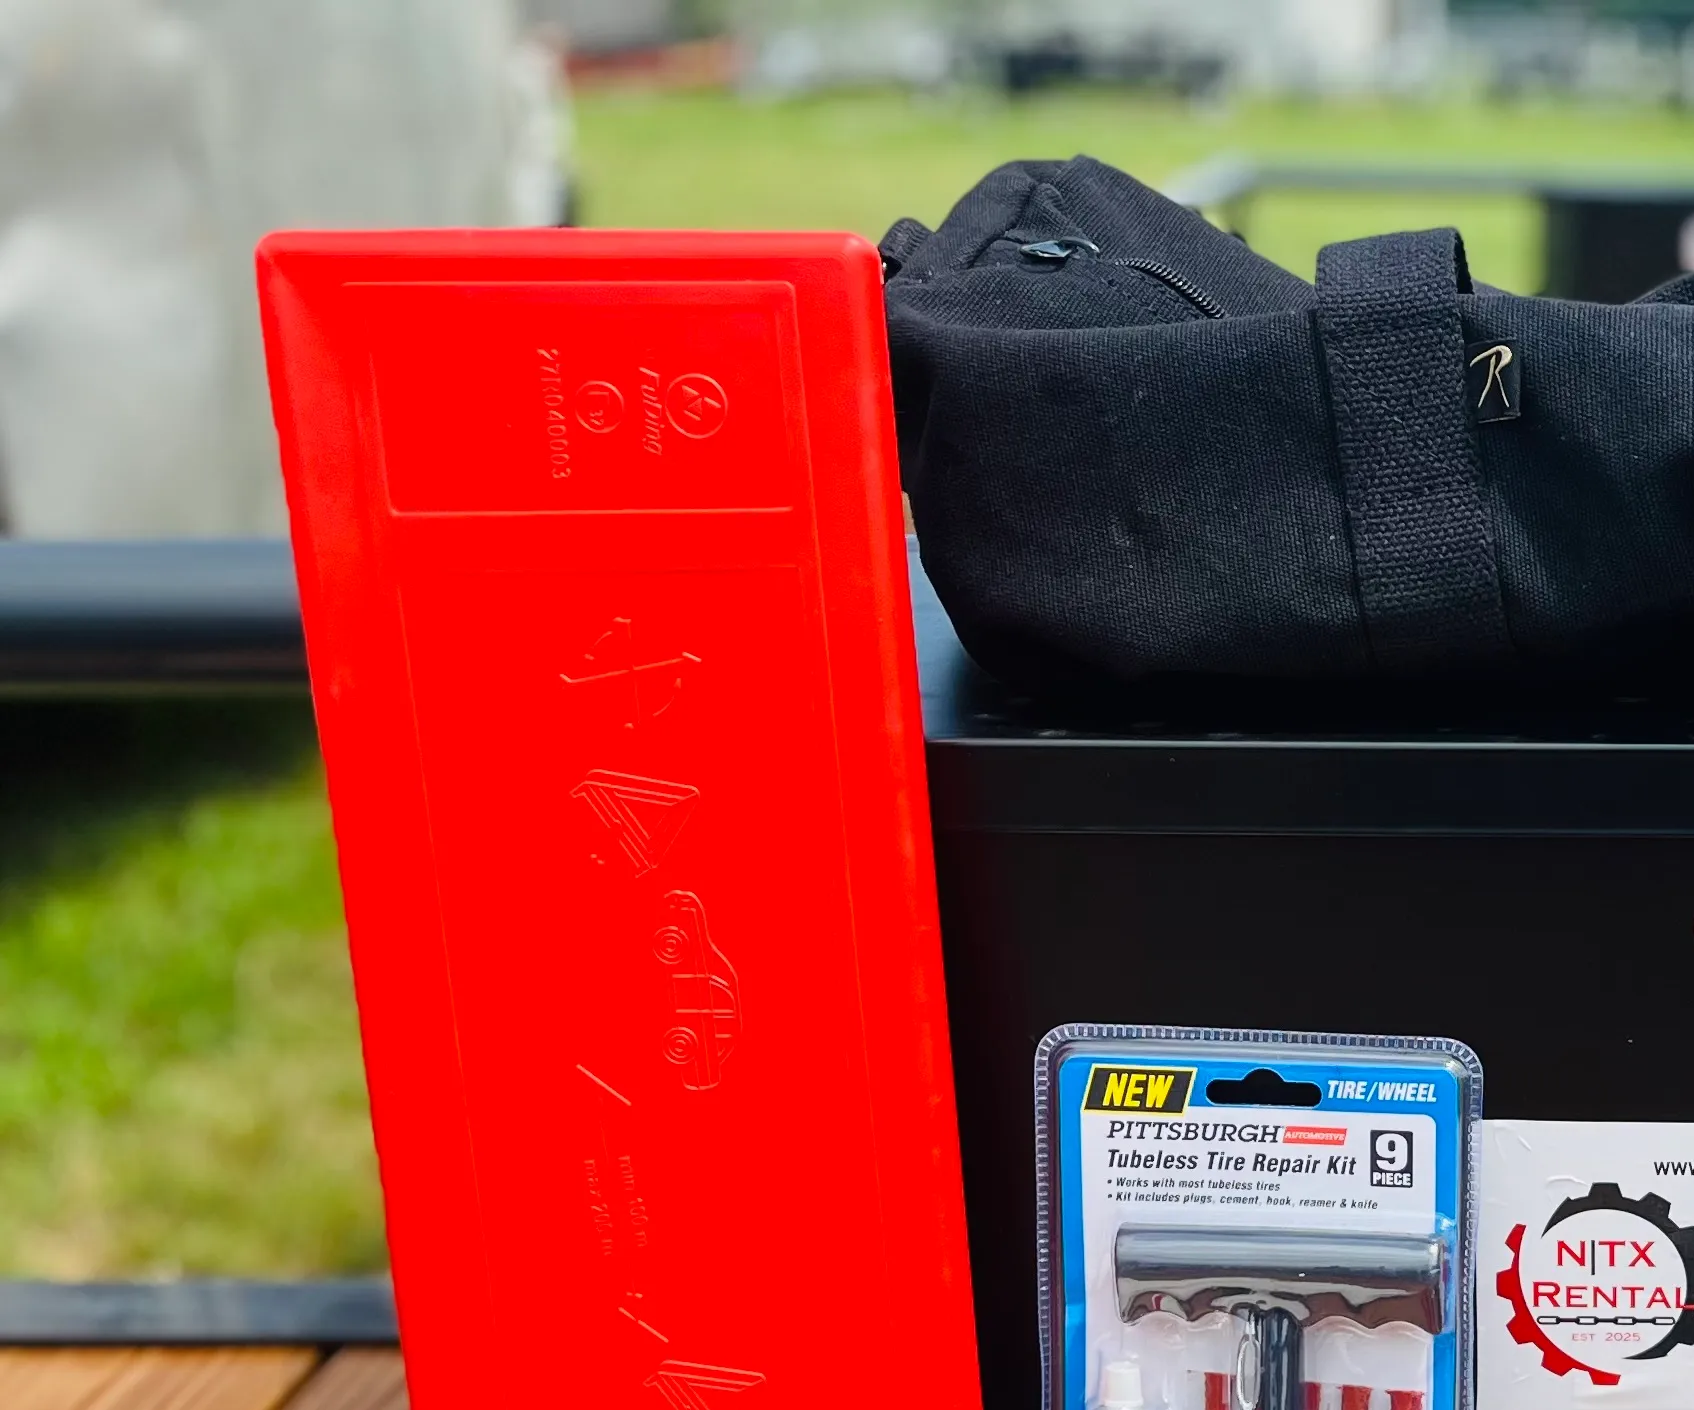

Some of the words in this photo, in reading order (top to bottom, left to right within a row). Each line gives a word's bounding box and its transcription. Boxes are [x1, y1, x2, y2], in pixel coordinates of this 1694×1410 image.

[1470, 345, 1512, 408] R
[1102, 1072, 1175, 1109] NEW
[1327, 1079, 1438, 1103] TIRE/WHEEL
[1106, 1120, 1281, 1144] PITTSBURGH
[1284, 1130, 1346, 1142] AUTOMOTIVE
[1107, 1148, 1199, 1170] Tubeless
[1207, 1151, 1245, 1171] Tire
[1252, 1153, 1321, 1177] Repair
[1326, 1155, 1357, 1176] Kit
[1375, 1132, 1409, 1172] 9
[1116, 1177, 1149, 1188] Works
[1152, 1177, 1175, 1188] with
[1178, 1179, 1204, 1189] most
[1208, 1180, 1253, 1191] tubeless
[1256, 1180, 1281, 1191] tires
[1372, 1172, 1412, 1187] PIECE
[1115, 1191, 1131, 1202] Kit
[1135, 1192, 1181, 1203] includes
[1183, 1194, 1215, 1205] plugs,
[1219, 1195, 1262, 1206] cement,
[1299, 1198, 1336, 1209] reamer
[1339, 1199, 1347, 1208] &
[1351, 1199, 1378, 1210] knife
[1571, 1332, 1596, 1342] EST
[1605, 1332, 1641, 1342] 2025
